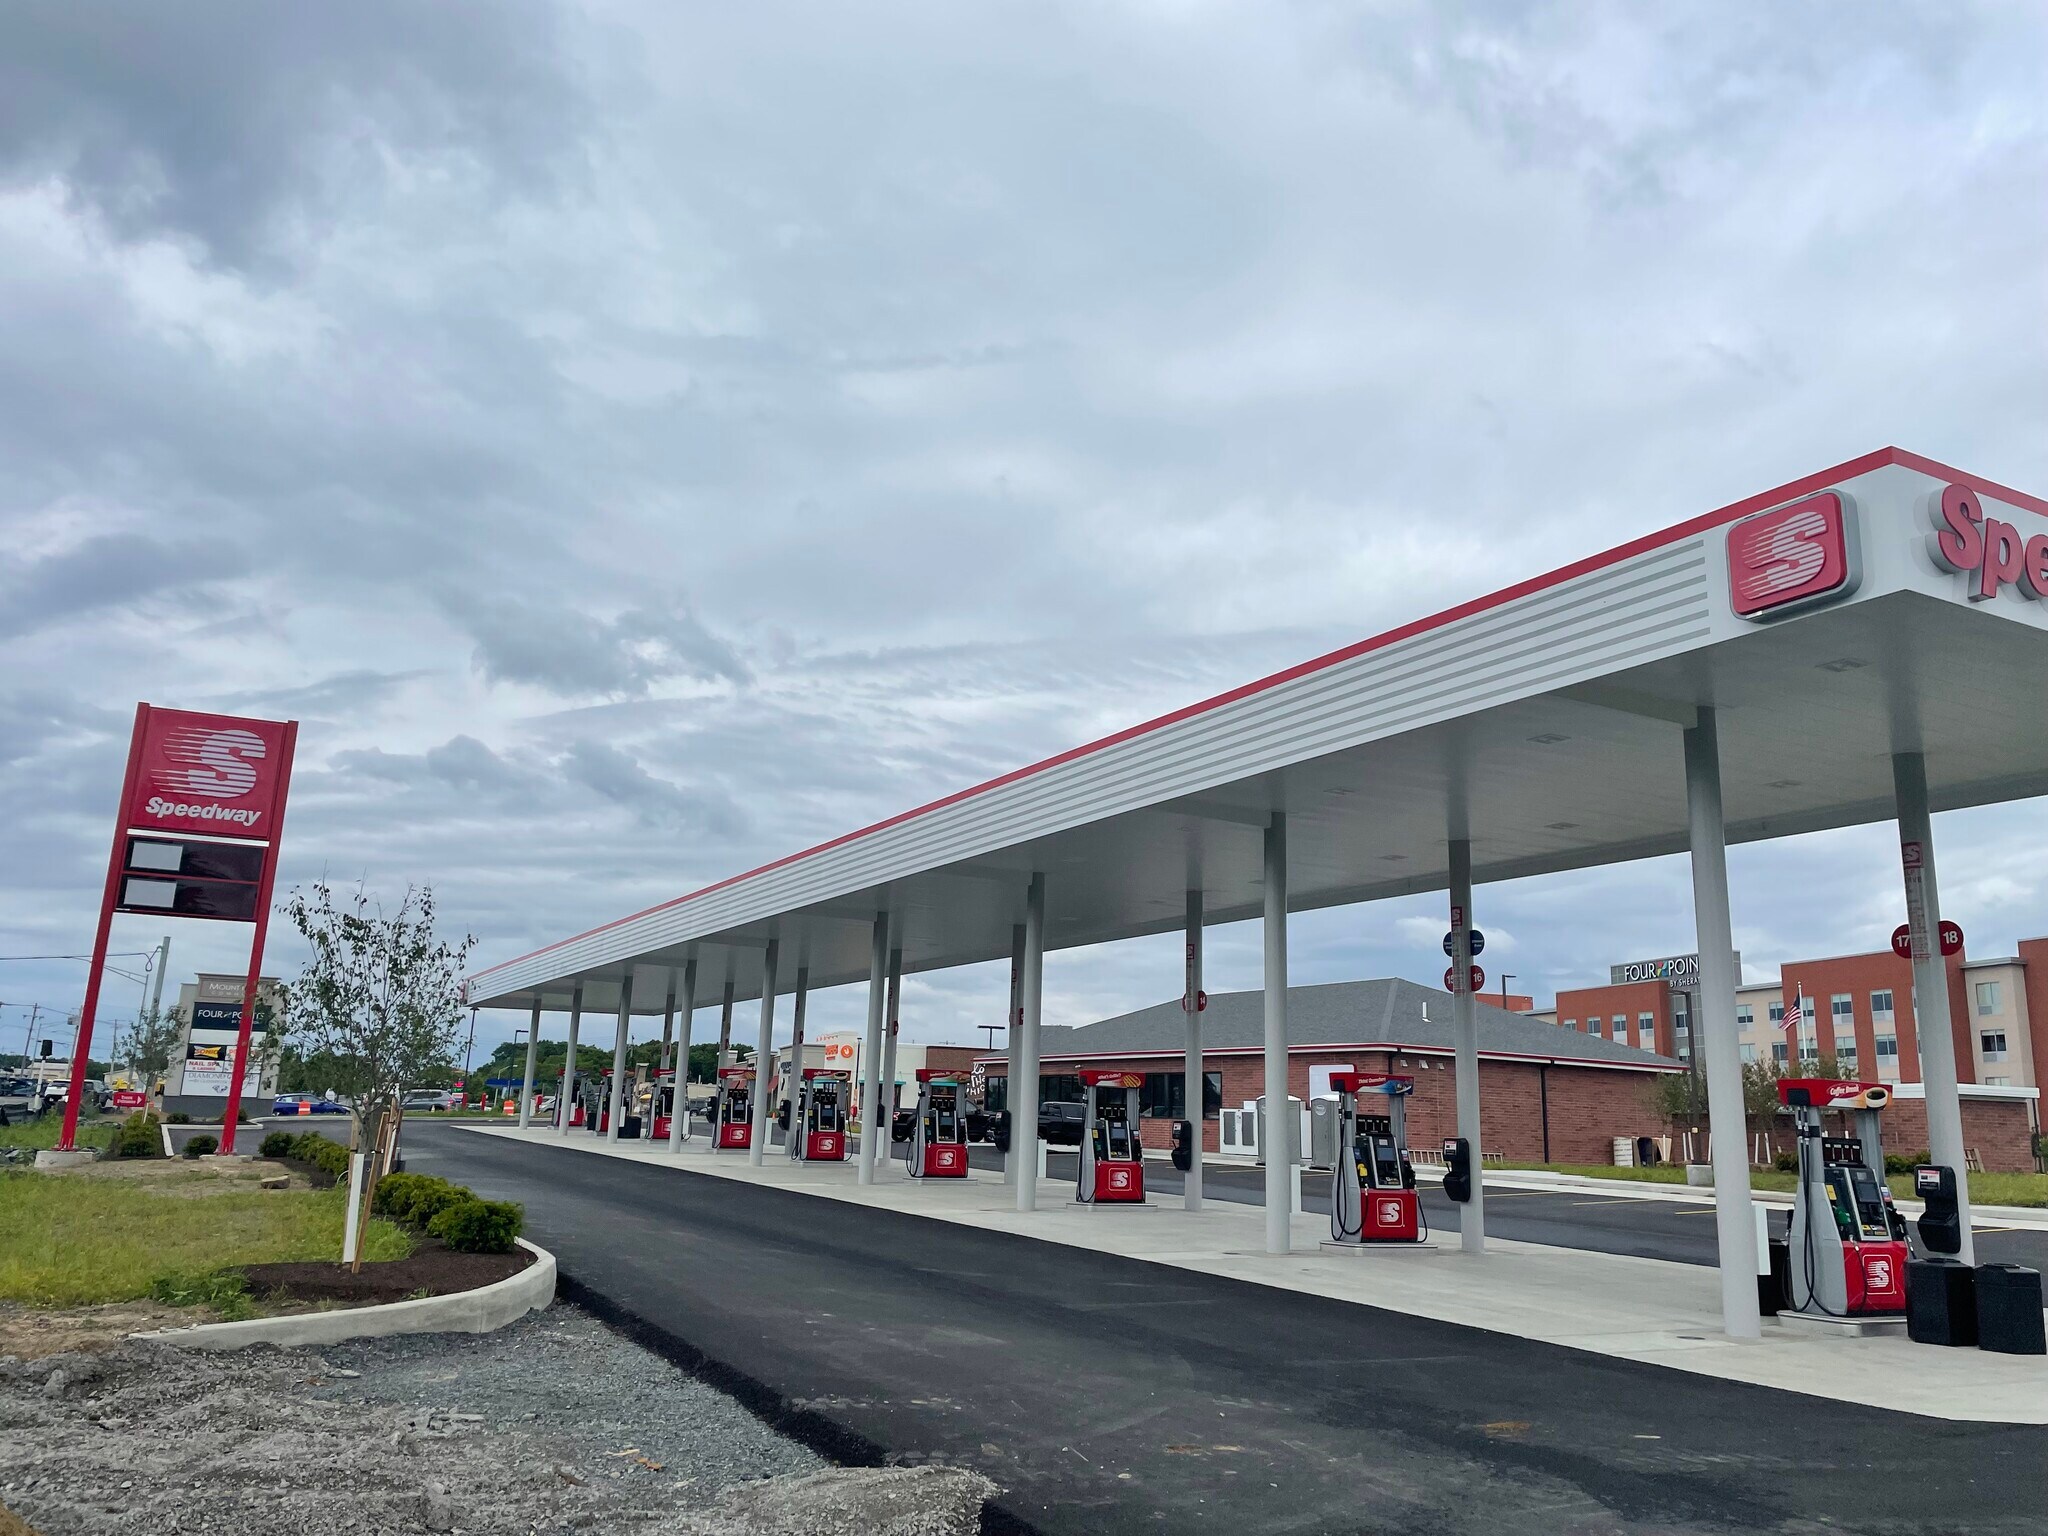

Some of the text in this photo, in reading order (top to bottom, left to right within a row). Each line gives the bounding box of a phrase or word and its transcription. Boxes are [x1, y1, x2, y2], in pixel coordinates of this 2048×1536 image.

[1739, 511, 1827, 600] S
[150, 727, 266, 798] S
[145, 797, 262, 827] Speedway
[1896, 935, 1910, 947] 17
[1943, 931, 1958, 944] 18
[1624, 956, 1699, 982] FOUR POIN
[1473, 972, 1483, 983] 16
[1669, 977, 1700, 988] BY SHERA
[209, 983, 240, 991] MOUNT
[197, 1009, 223, 1019] FOUR
[1830, 1087, 1845, 1097] Coffee
[937, 1152, 954, 1166] S
[1111, 1171, 1128, 1187] S
[1380, 1203, 1400, 1222] S
[1867, 1260, 1889, 1288] S
